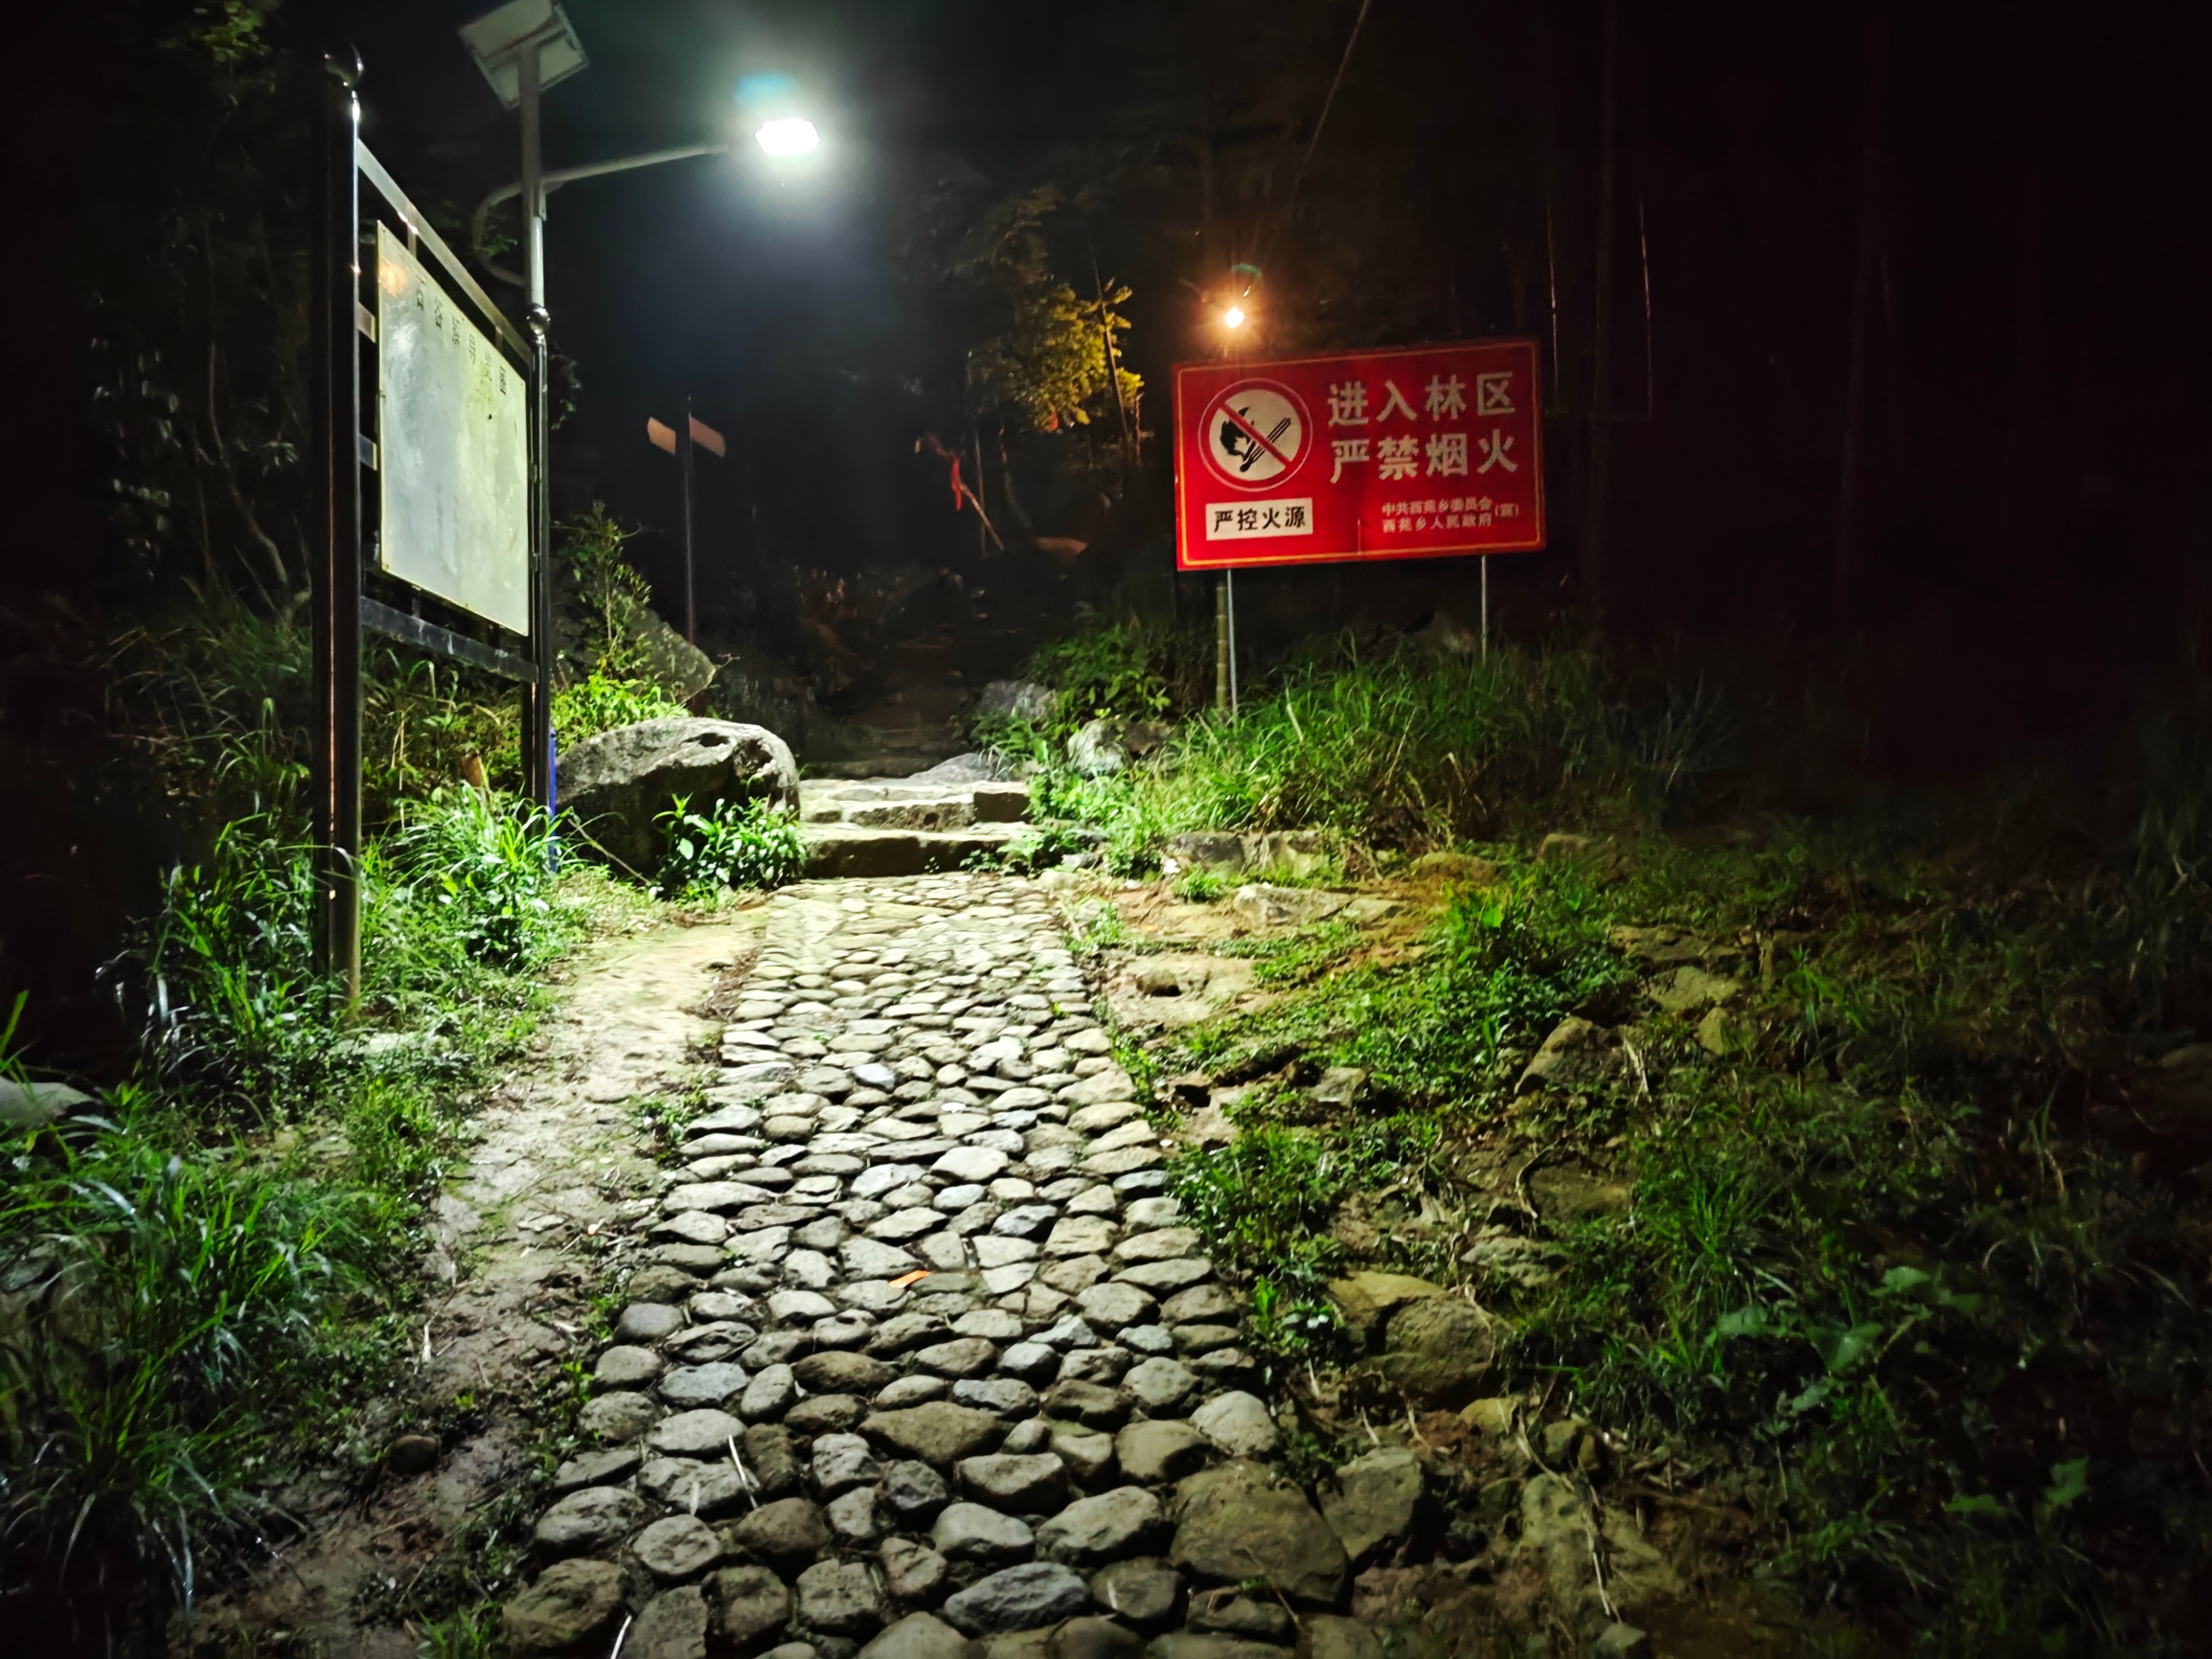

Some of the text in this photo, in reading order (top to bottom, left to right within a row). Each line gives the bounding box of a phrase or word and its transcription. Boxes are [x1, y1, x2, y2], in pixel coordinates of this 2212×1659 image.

[1327, 371, 1516, 427] 进入林区
[1330, 427, 1519, 485] 严禁烟火
[1214, 506, 1307, 534] 严控火源
